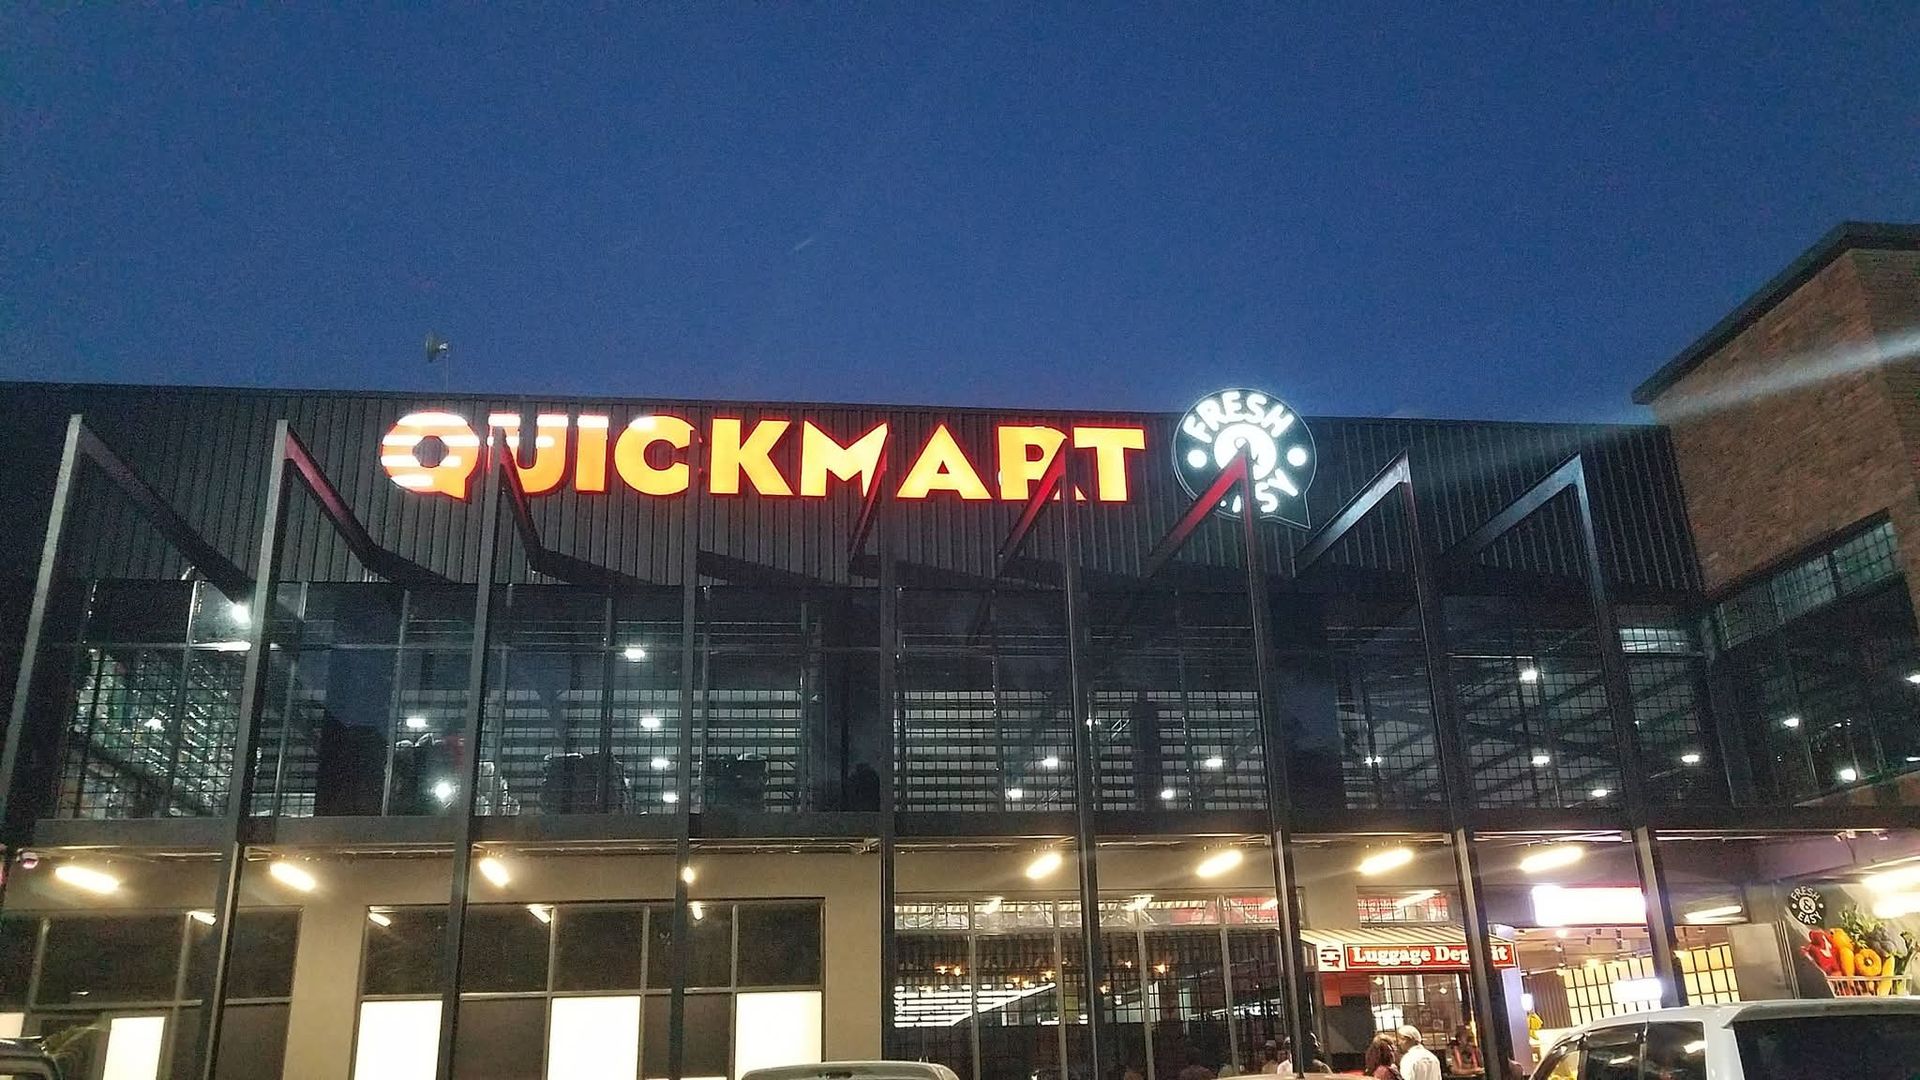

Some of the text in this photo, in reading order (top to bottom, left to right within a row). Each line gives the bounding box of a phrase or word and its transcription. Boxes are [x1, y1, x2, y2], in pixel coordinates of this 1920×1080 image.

[1182, 391, 1295, 444] FRESH
[381, 411, 1146, 502] QUICKMART
[1790, 886, 1821, 901] FRESH
[1797, 911, 1822, 924] EASY
[1352, 945, 1508, 965] Luggage Depit
